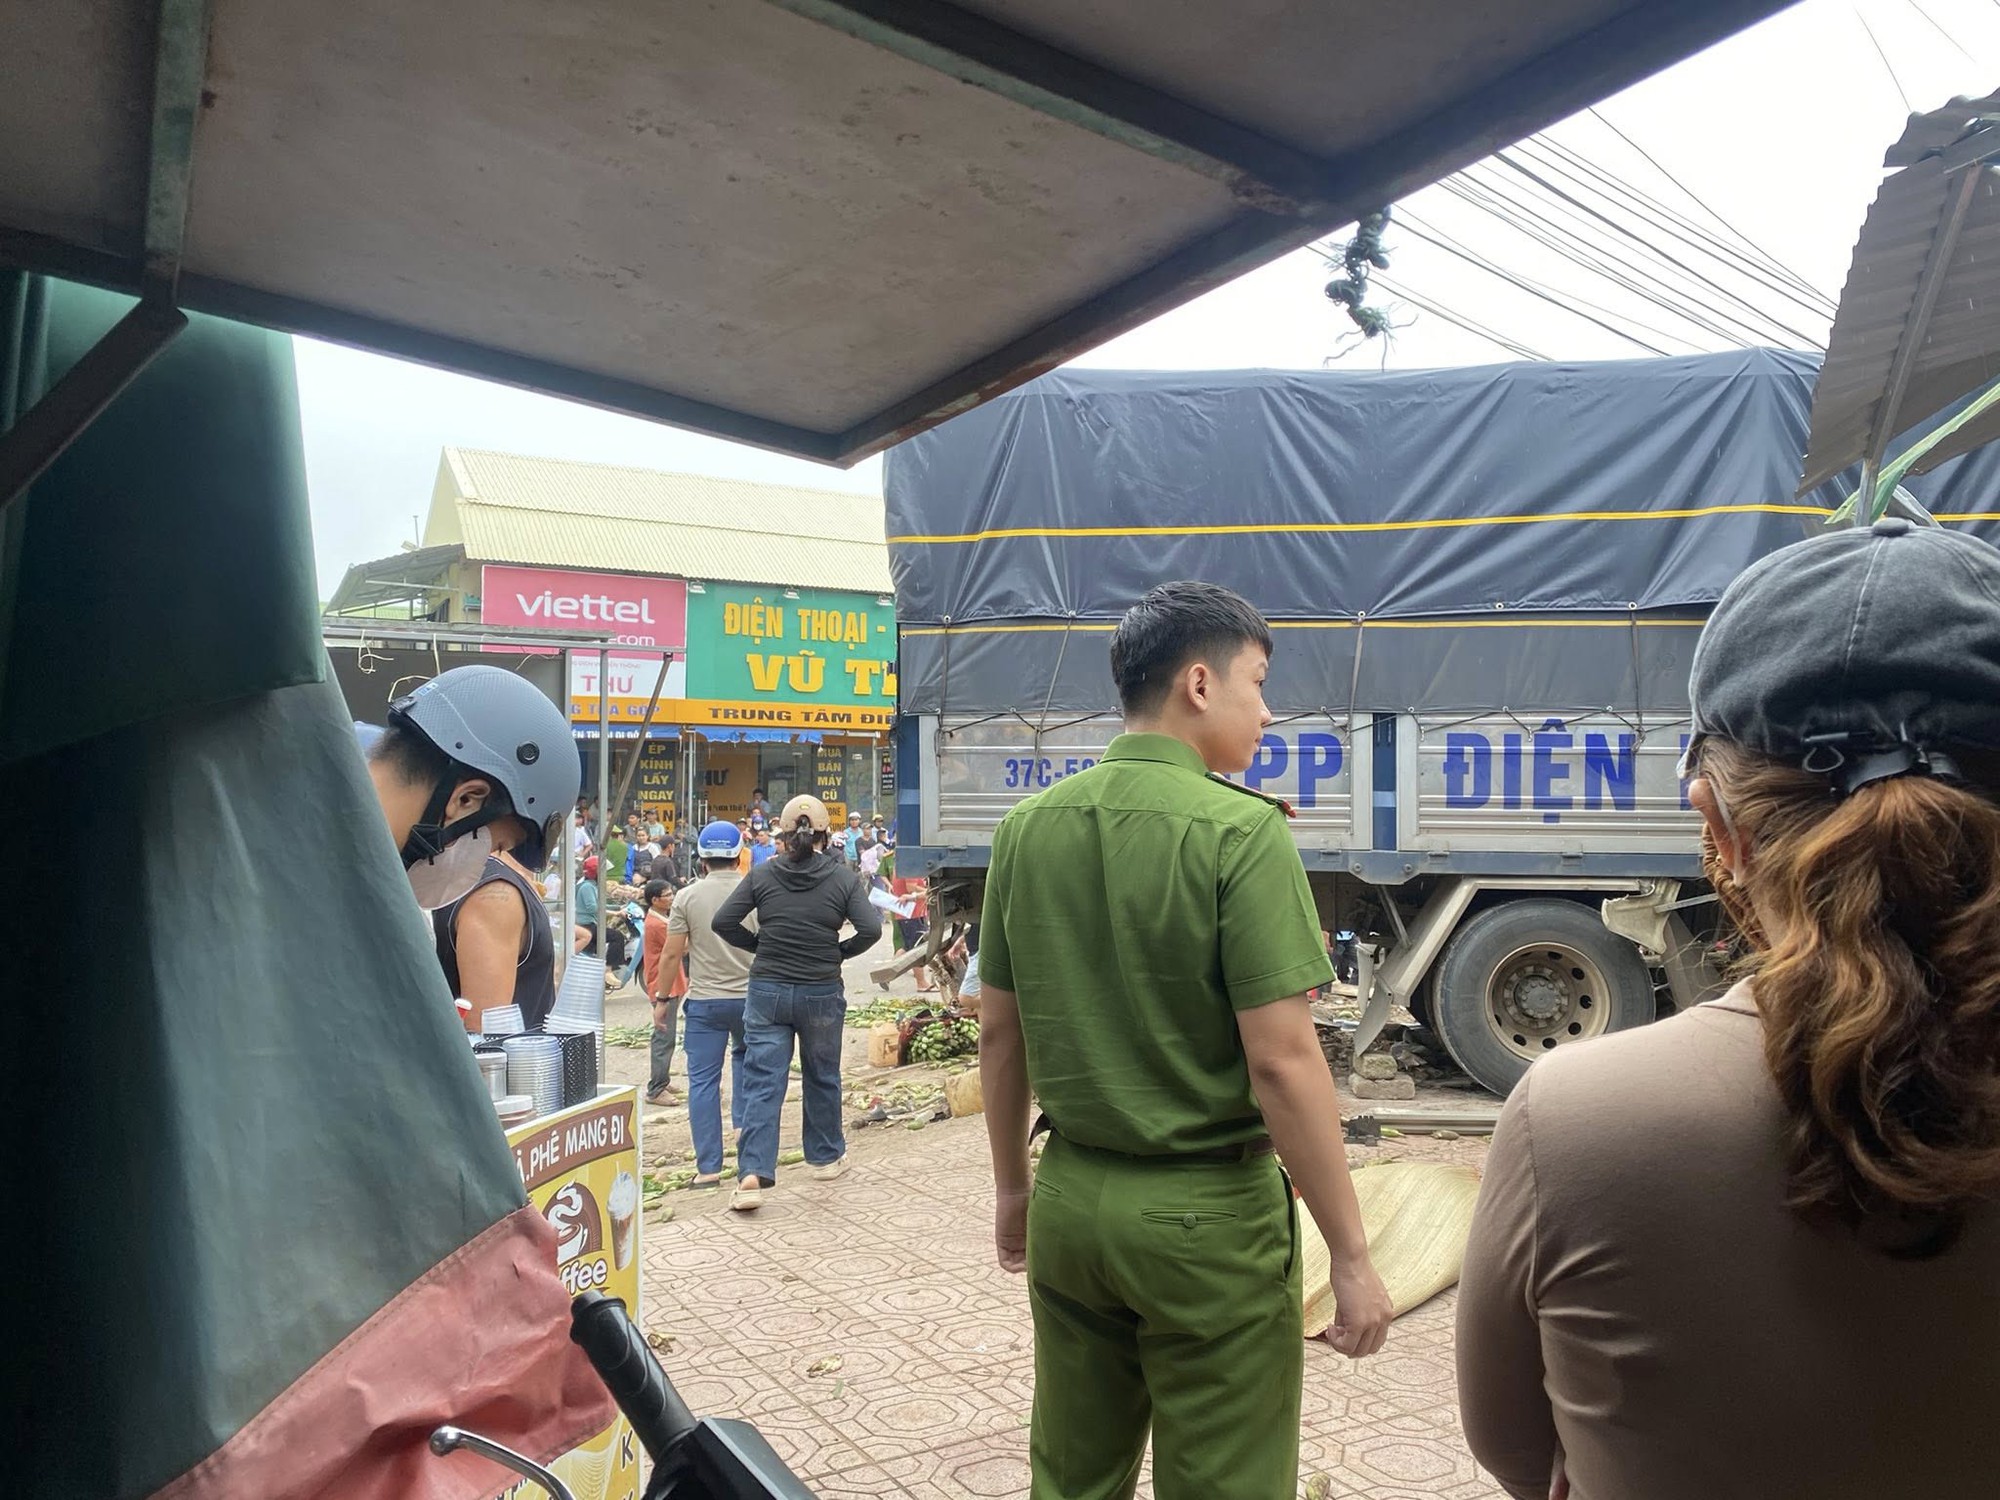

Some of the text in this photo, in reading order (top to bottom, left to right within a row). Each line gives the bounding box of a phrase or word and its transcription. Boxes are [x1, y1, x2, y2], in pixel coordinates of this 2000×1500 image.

[515, 591, 656, 624] viettel
[724, 597, 784, 645] ĐIỆN
[797, 608, 868, 650] THOẠI
[746, 650, 826, 692] VŨ
[708, 707, 792, 722] TRUNG
[800, 709, 852, 724] TÂM
[648, 742, 666, 754] ÉP
[639, 758, 673, 770] KÍNH
[817, 760, 842, 772] BÁN
[1232, 733, 1343, 808] PP
[1443, 718, 1636, 823] ĐIỆN
[643, 771, 669, 785] LẤY
[817, 774, 843, 786] MÁY
[1005, 758, 1100, 787] 37C-5
[638, 790, 674, 800] NGAY
[822, 788, 837, 800] CŨ
[564, 1116, 608, 1158] MANG
[611, 1115, 624, 1146] ĐI
